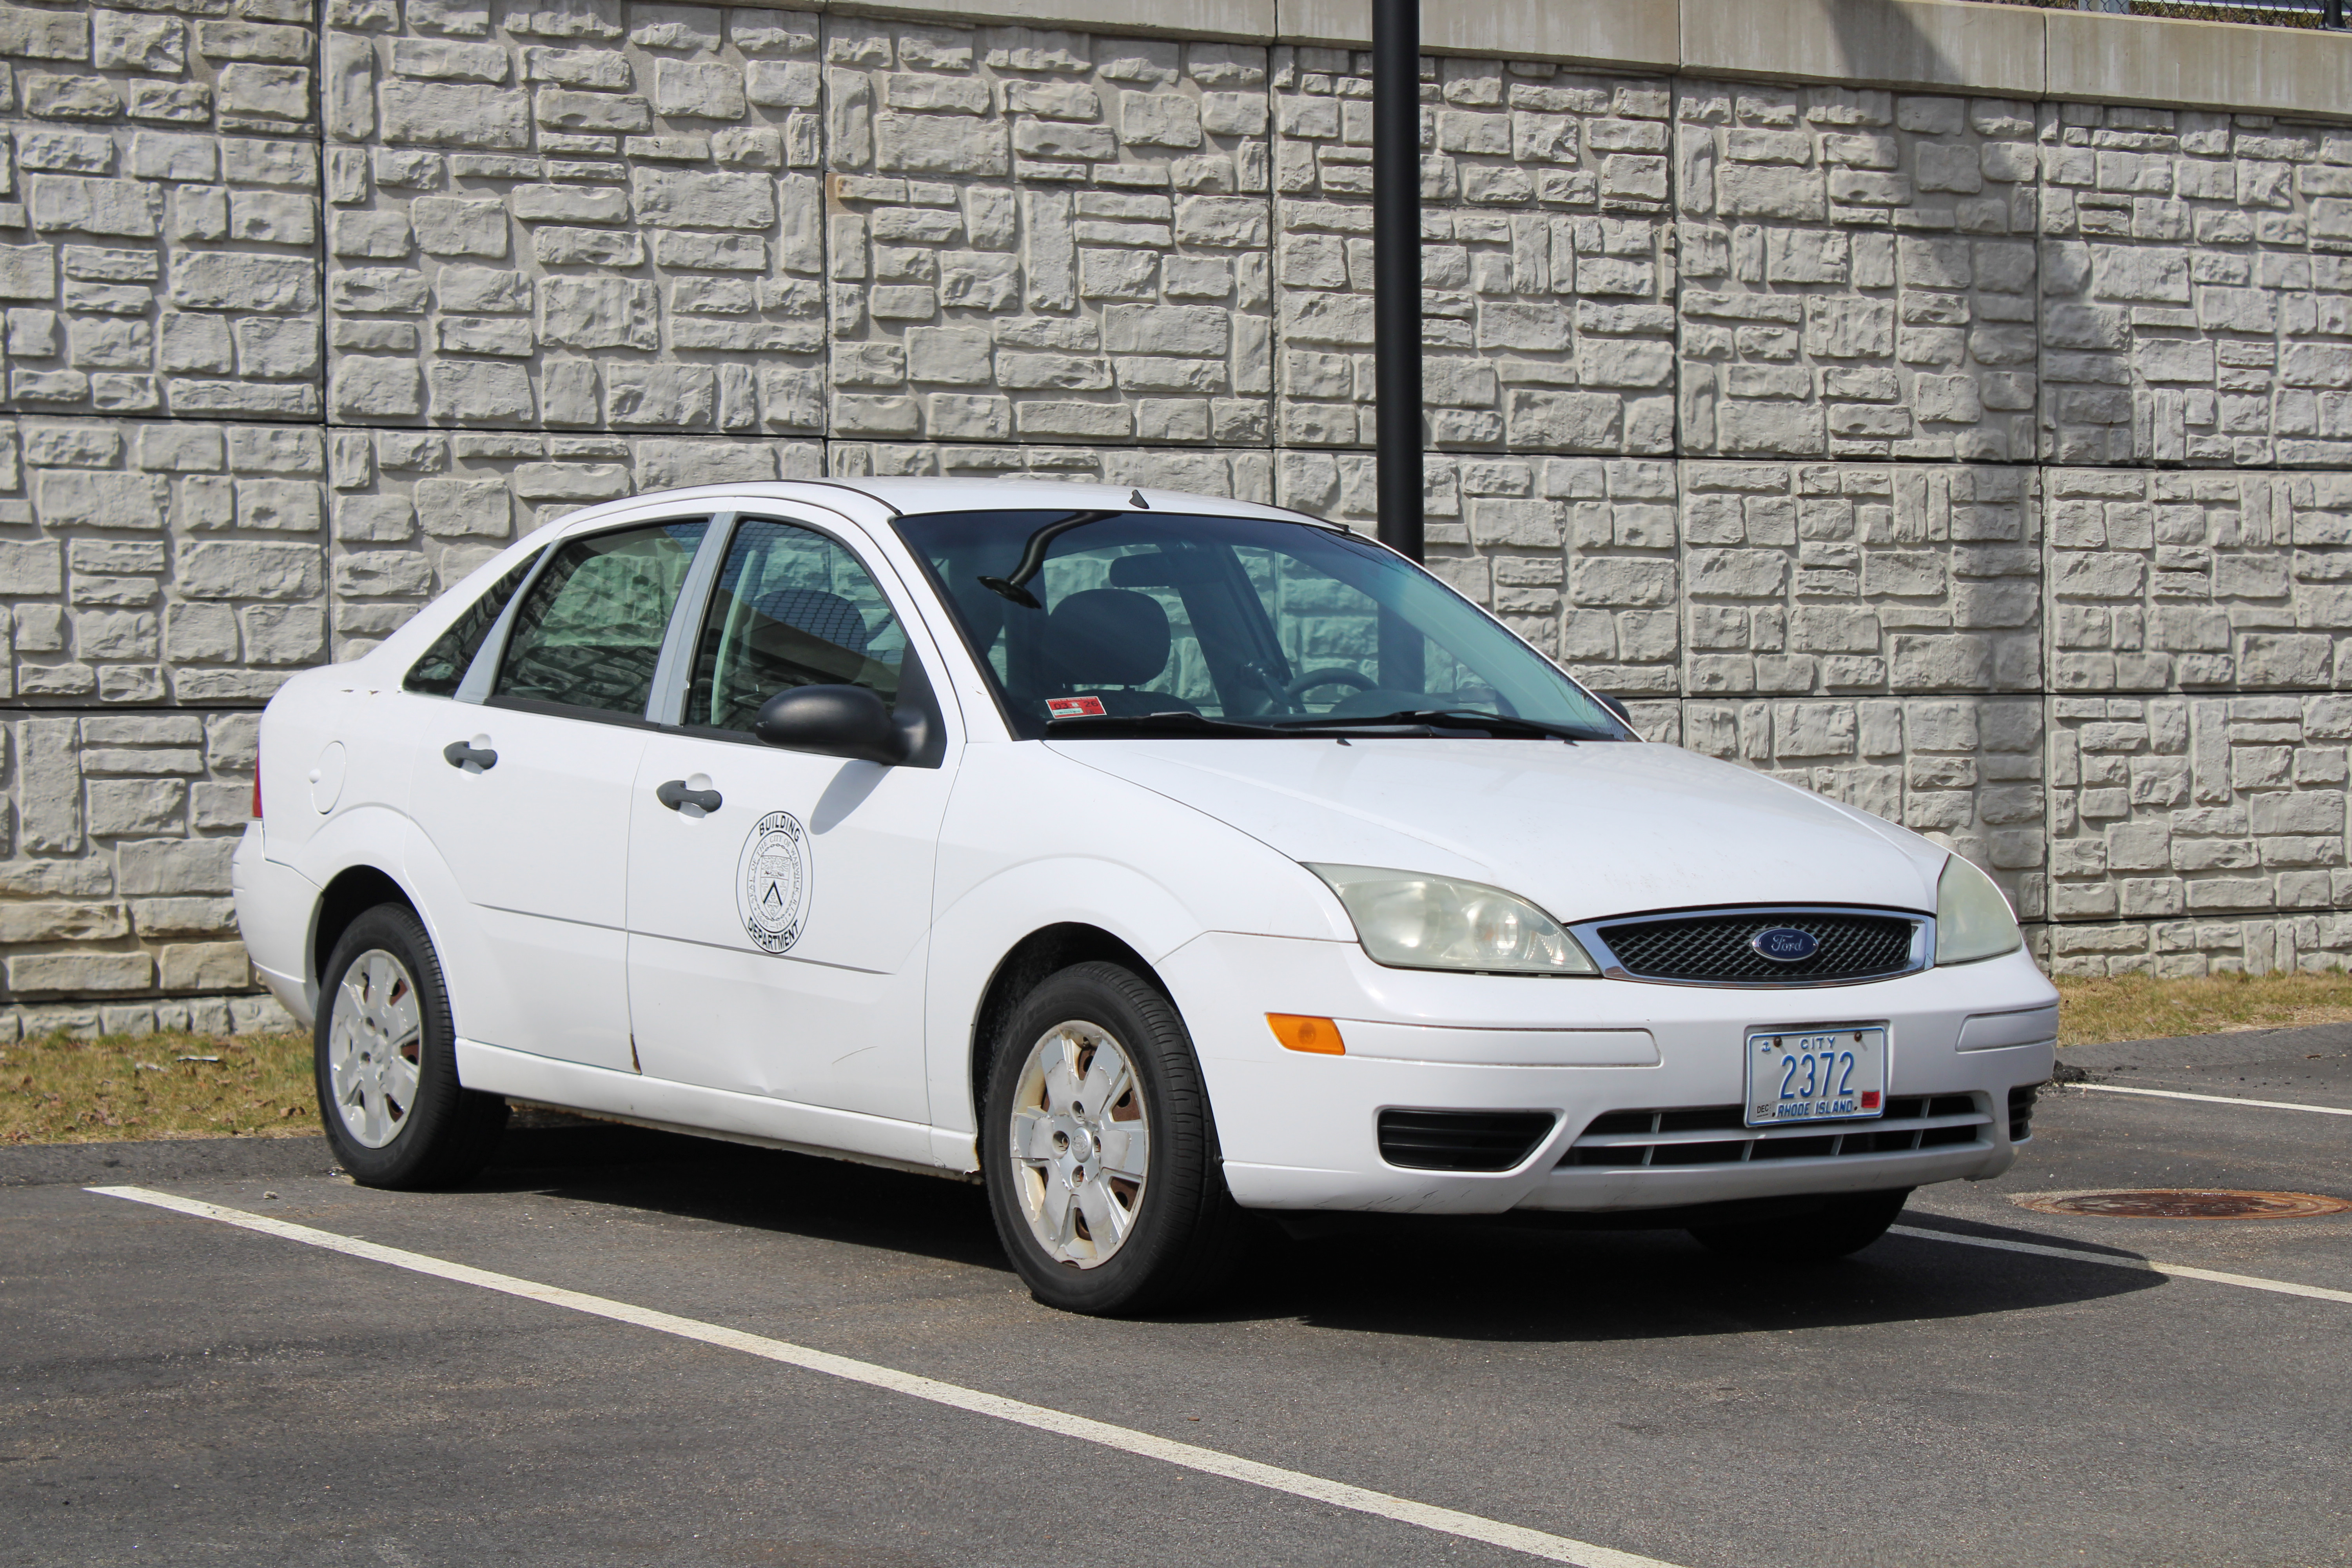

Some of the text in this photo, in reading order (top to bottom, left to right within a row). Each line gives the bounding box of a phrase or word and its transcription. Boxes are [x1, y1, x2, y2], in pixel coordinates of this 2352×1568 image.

[759, 815, 800, 842] BUILDING
[751, 858, 757, 871] OF
[756, 840, 768, 857] THE
[769, 835, 782, 843] CITY
[784, 838, 791, 848] OF
[748, 915, 799, 951] DEPARTMENT
[1771, 934, 1804, 951] Ford
[1800, 1036, 1835, 1049] CITY
[1779, 1051, 1854, 1099] 2372
[1757, 1104, 1769, 1113] DEC
[1777, 1102, 1811, 1117] RHODE
[1815, 1099, 1853, 1114] ISLAND
